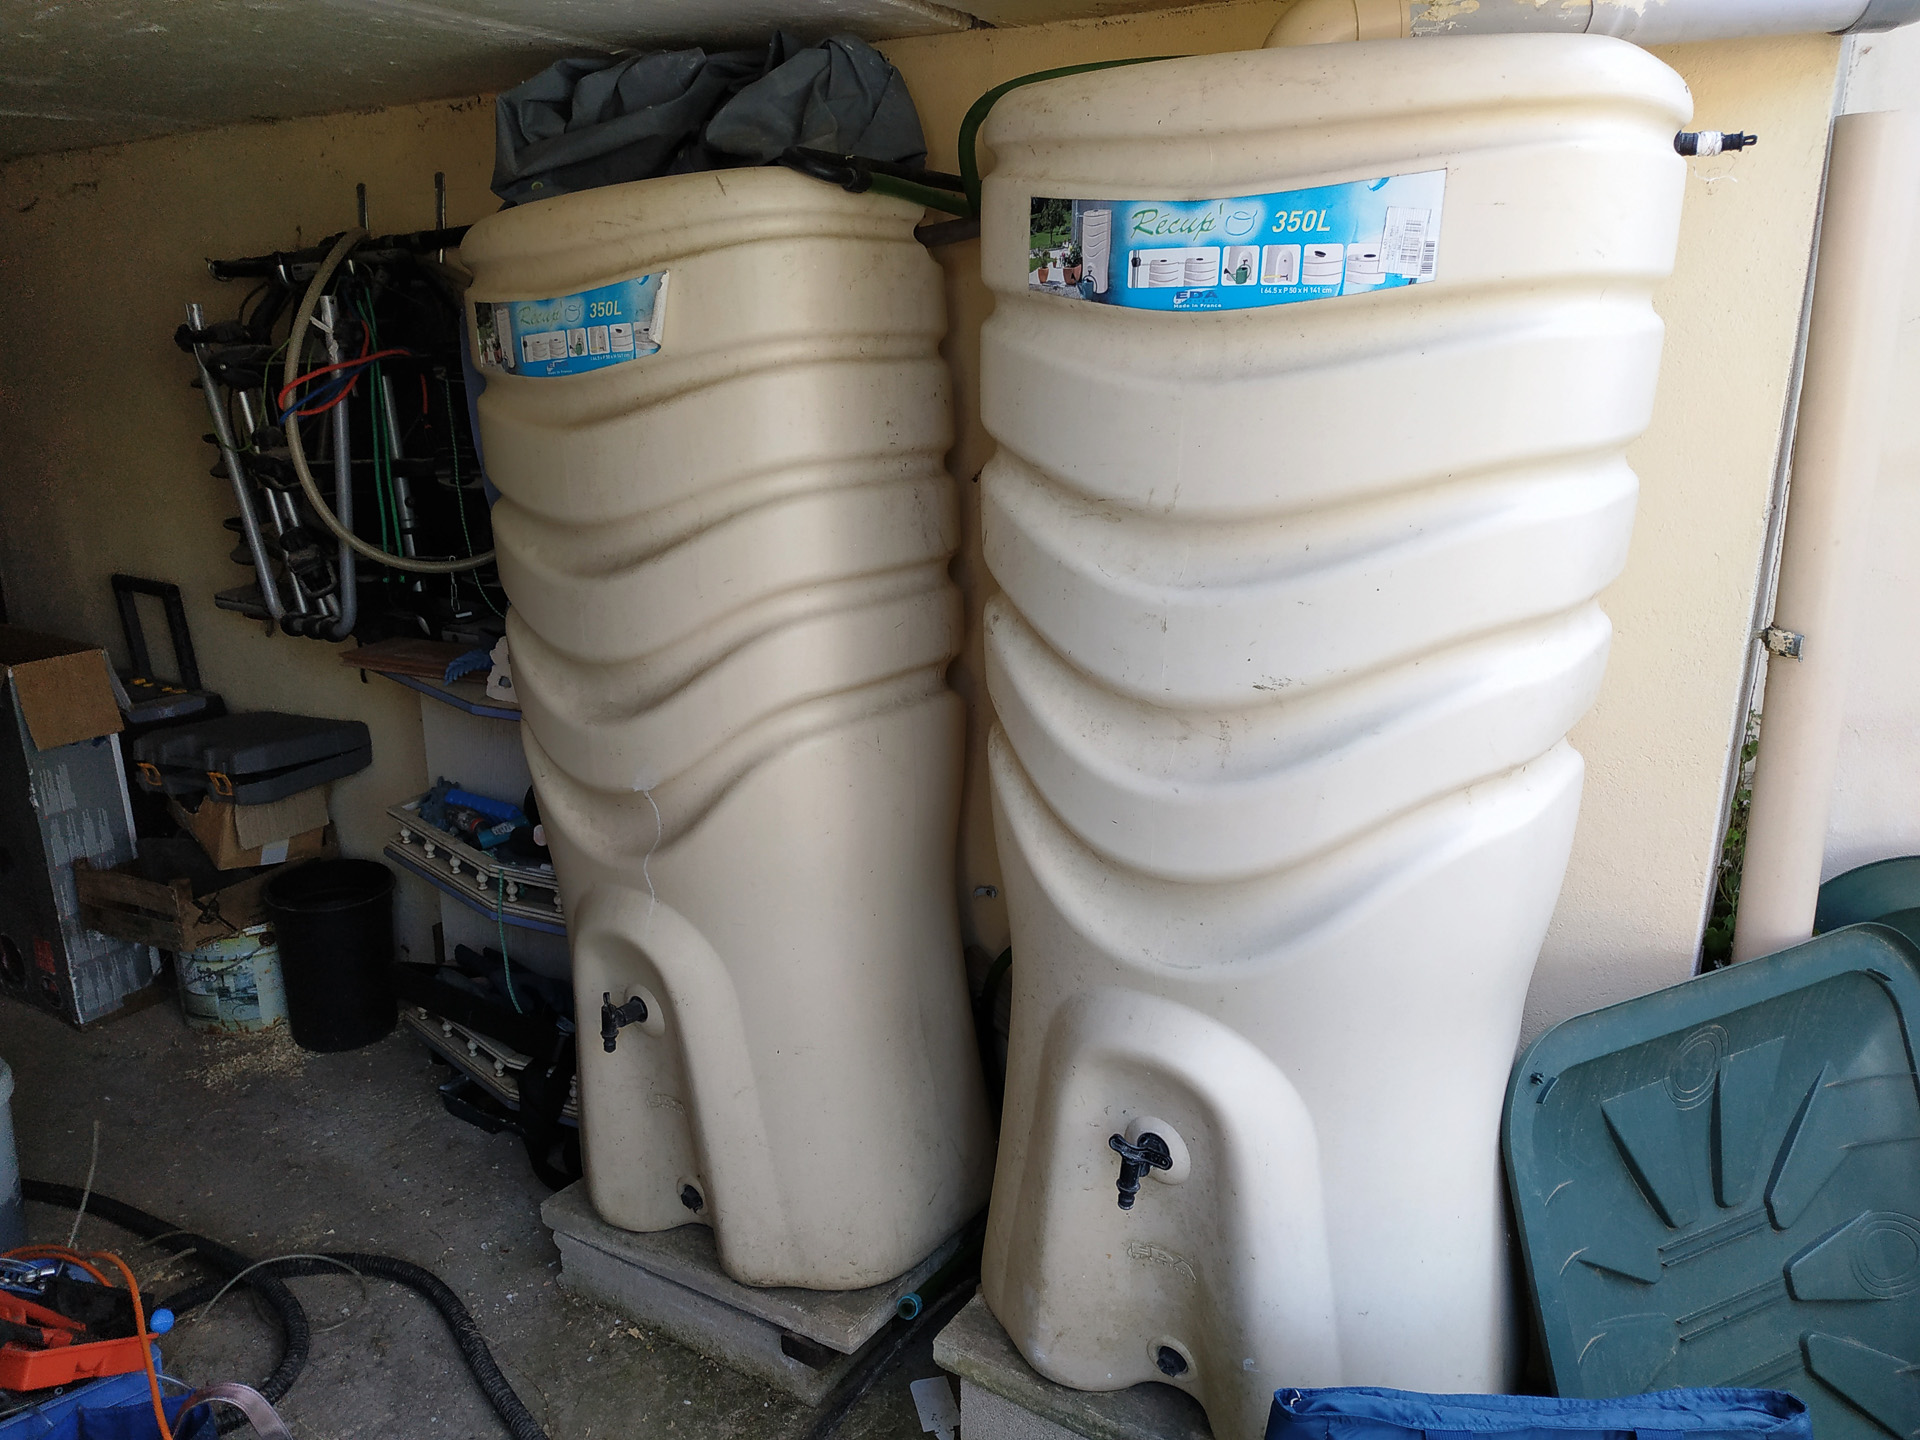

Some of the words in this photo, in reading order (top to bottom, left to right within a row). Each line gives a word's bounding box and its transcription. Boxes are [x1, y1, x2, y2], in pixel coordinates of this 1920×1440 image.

[1272, 209, 1330, 232] 350L
[1176, 291, 1218, 299] EDA
[589, 301, 622, 318] 350L
